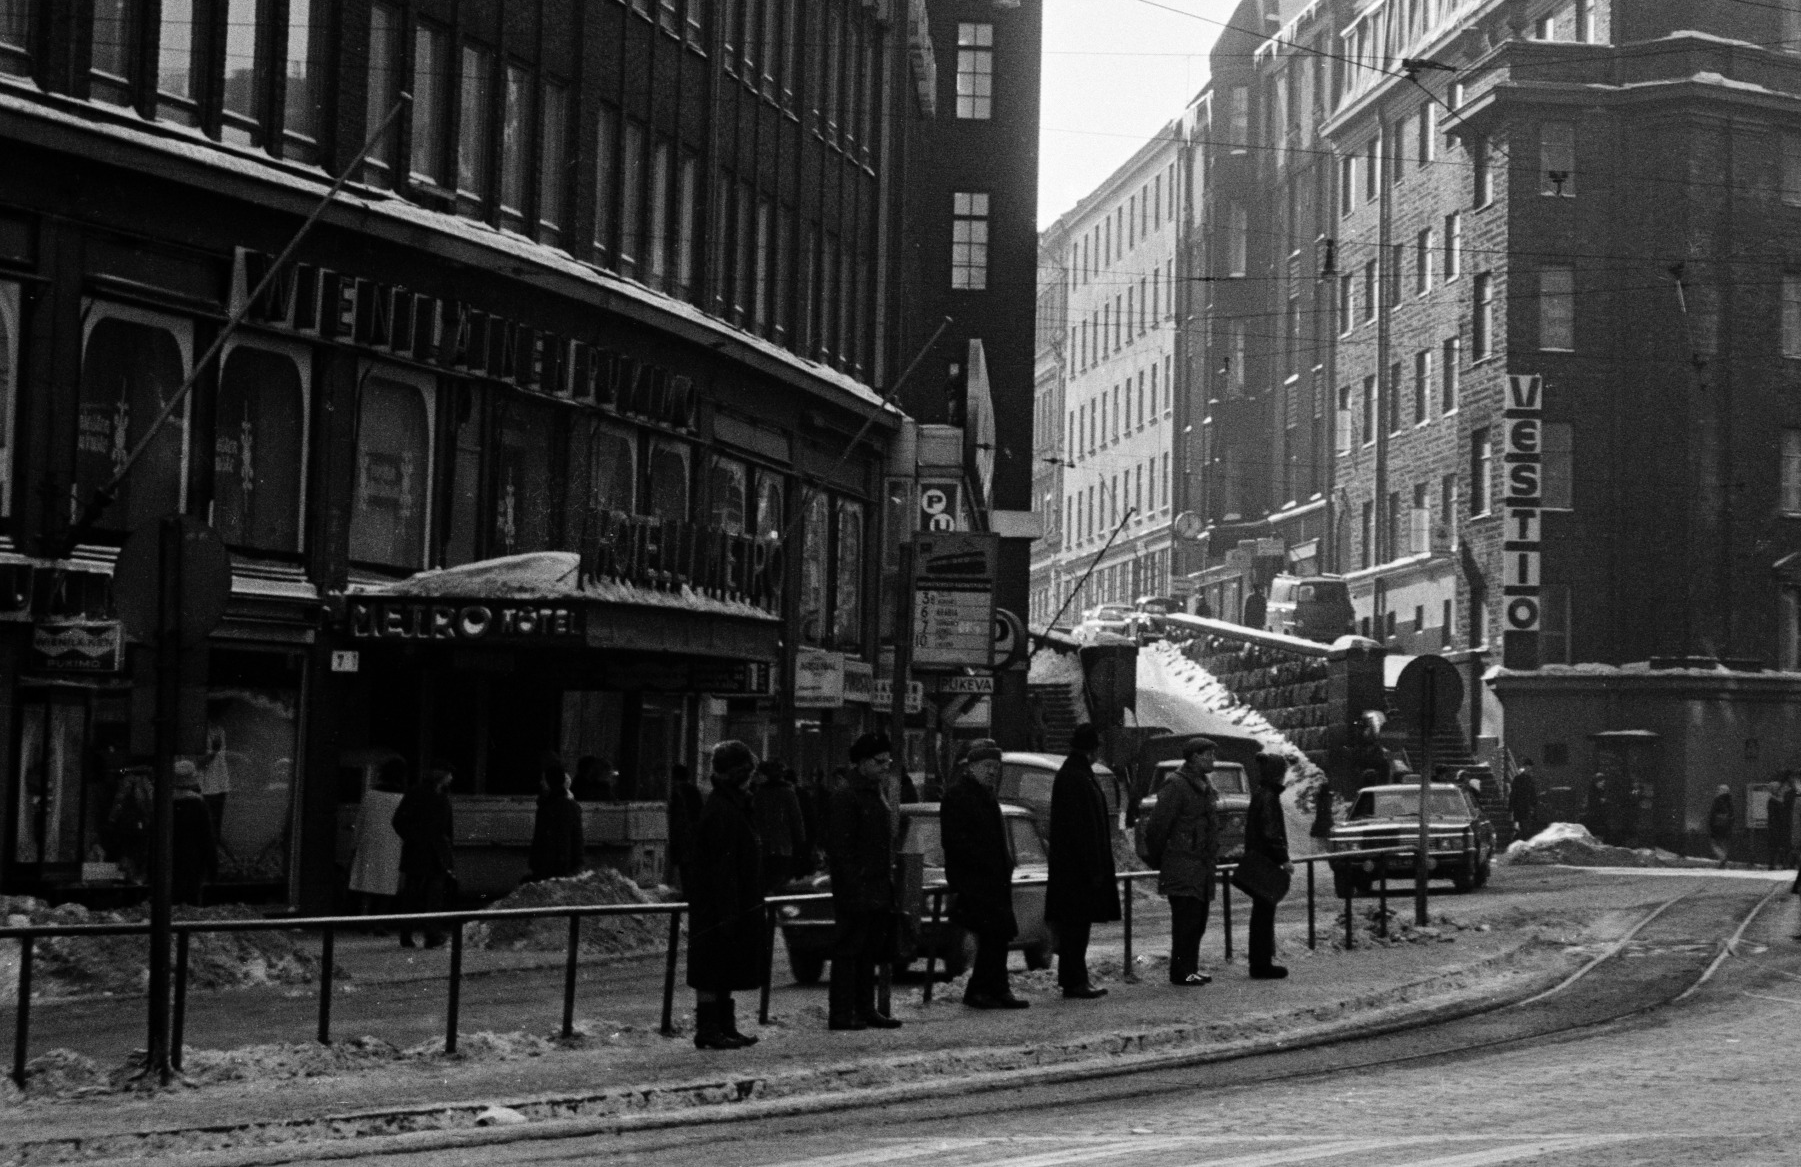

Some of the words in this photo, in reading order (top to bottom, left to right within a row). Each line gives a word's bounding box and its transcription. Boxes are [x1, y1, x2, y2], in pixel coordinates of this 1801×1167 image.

[1509, 376, 1541, 629] VESTIO
[350, 604, 493, 639] METRO
[500, 605, 582, 636] HOTEL
[941, 677, 993, 691] PUKEVA
